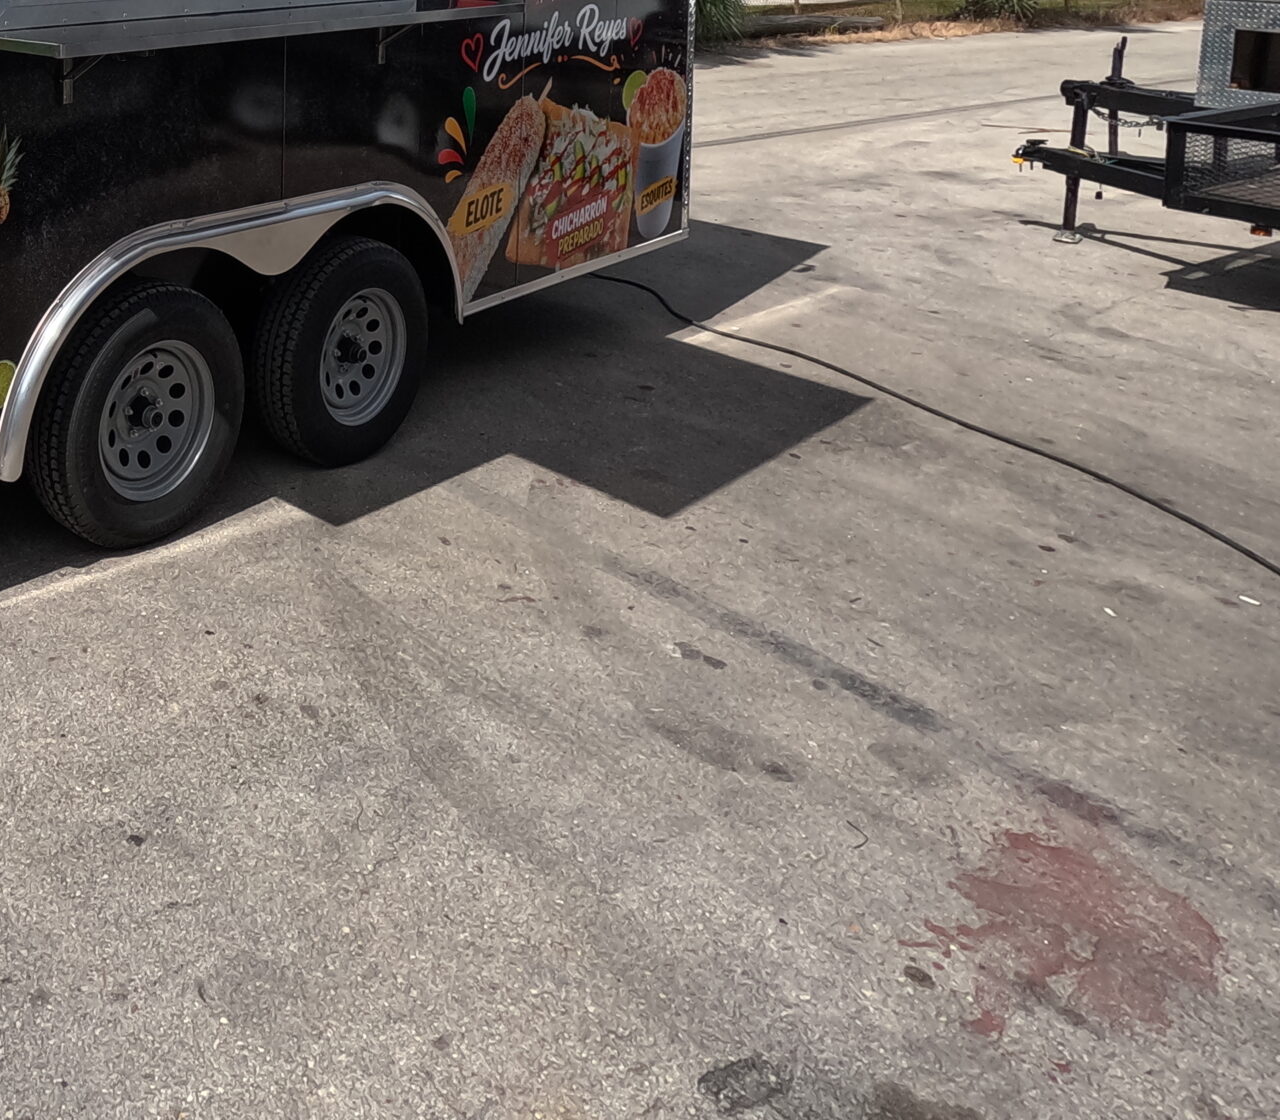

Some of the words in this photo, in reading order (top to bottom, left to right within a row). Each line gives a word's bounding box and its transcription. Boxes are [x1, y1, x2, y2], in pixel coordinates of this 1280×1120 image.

[483, 10, 575, 83] Jennifer
[576, 3, 628, 57] Reyes
[465, 187, 504, 228] ELOTE
[640, 178, 673, 211] ESQUITES
[551, 194, 608, 239] CHICHARRÓN
[557, 219, 604, 256] PREPARADO
